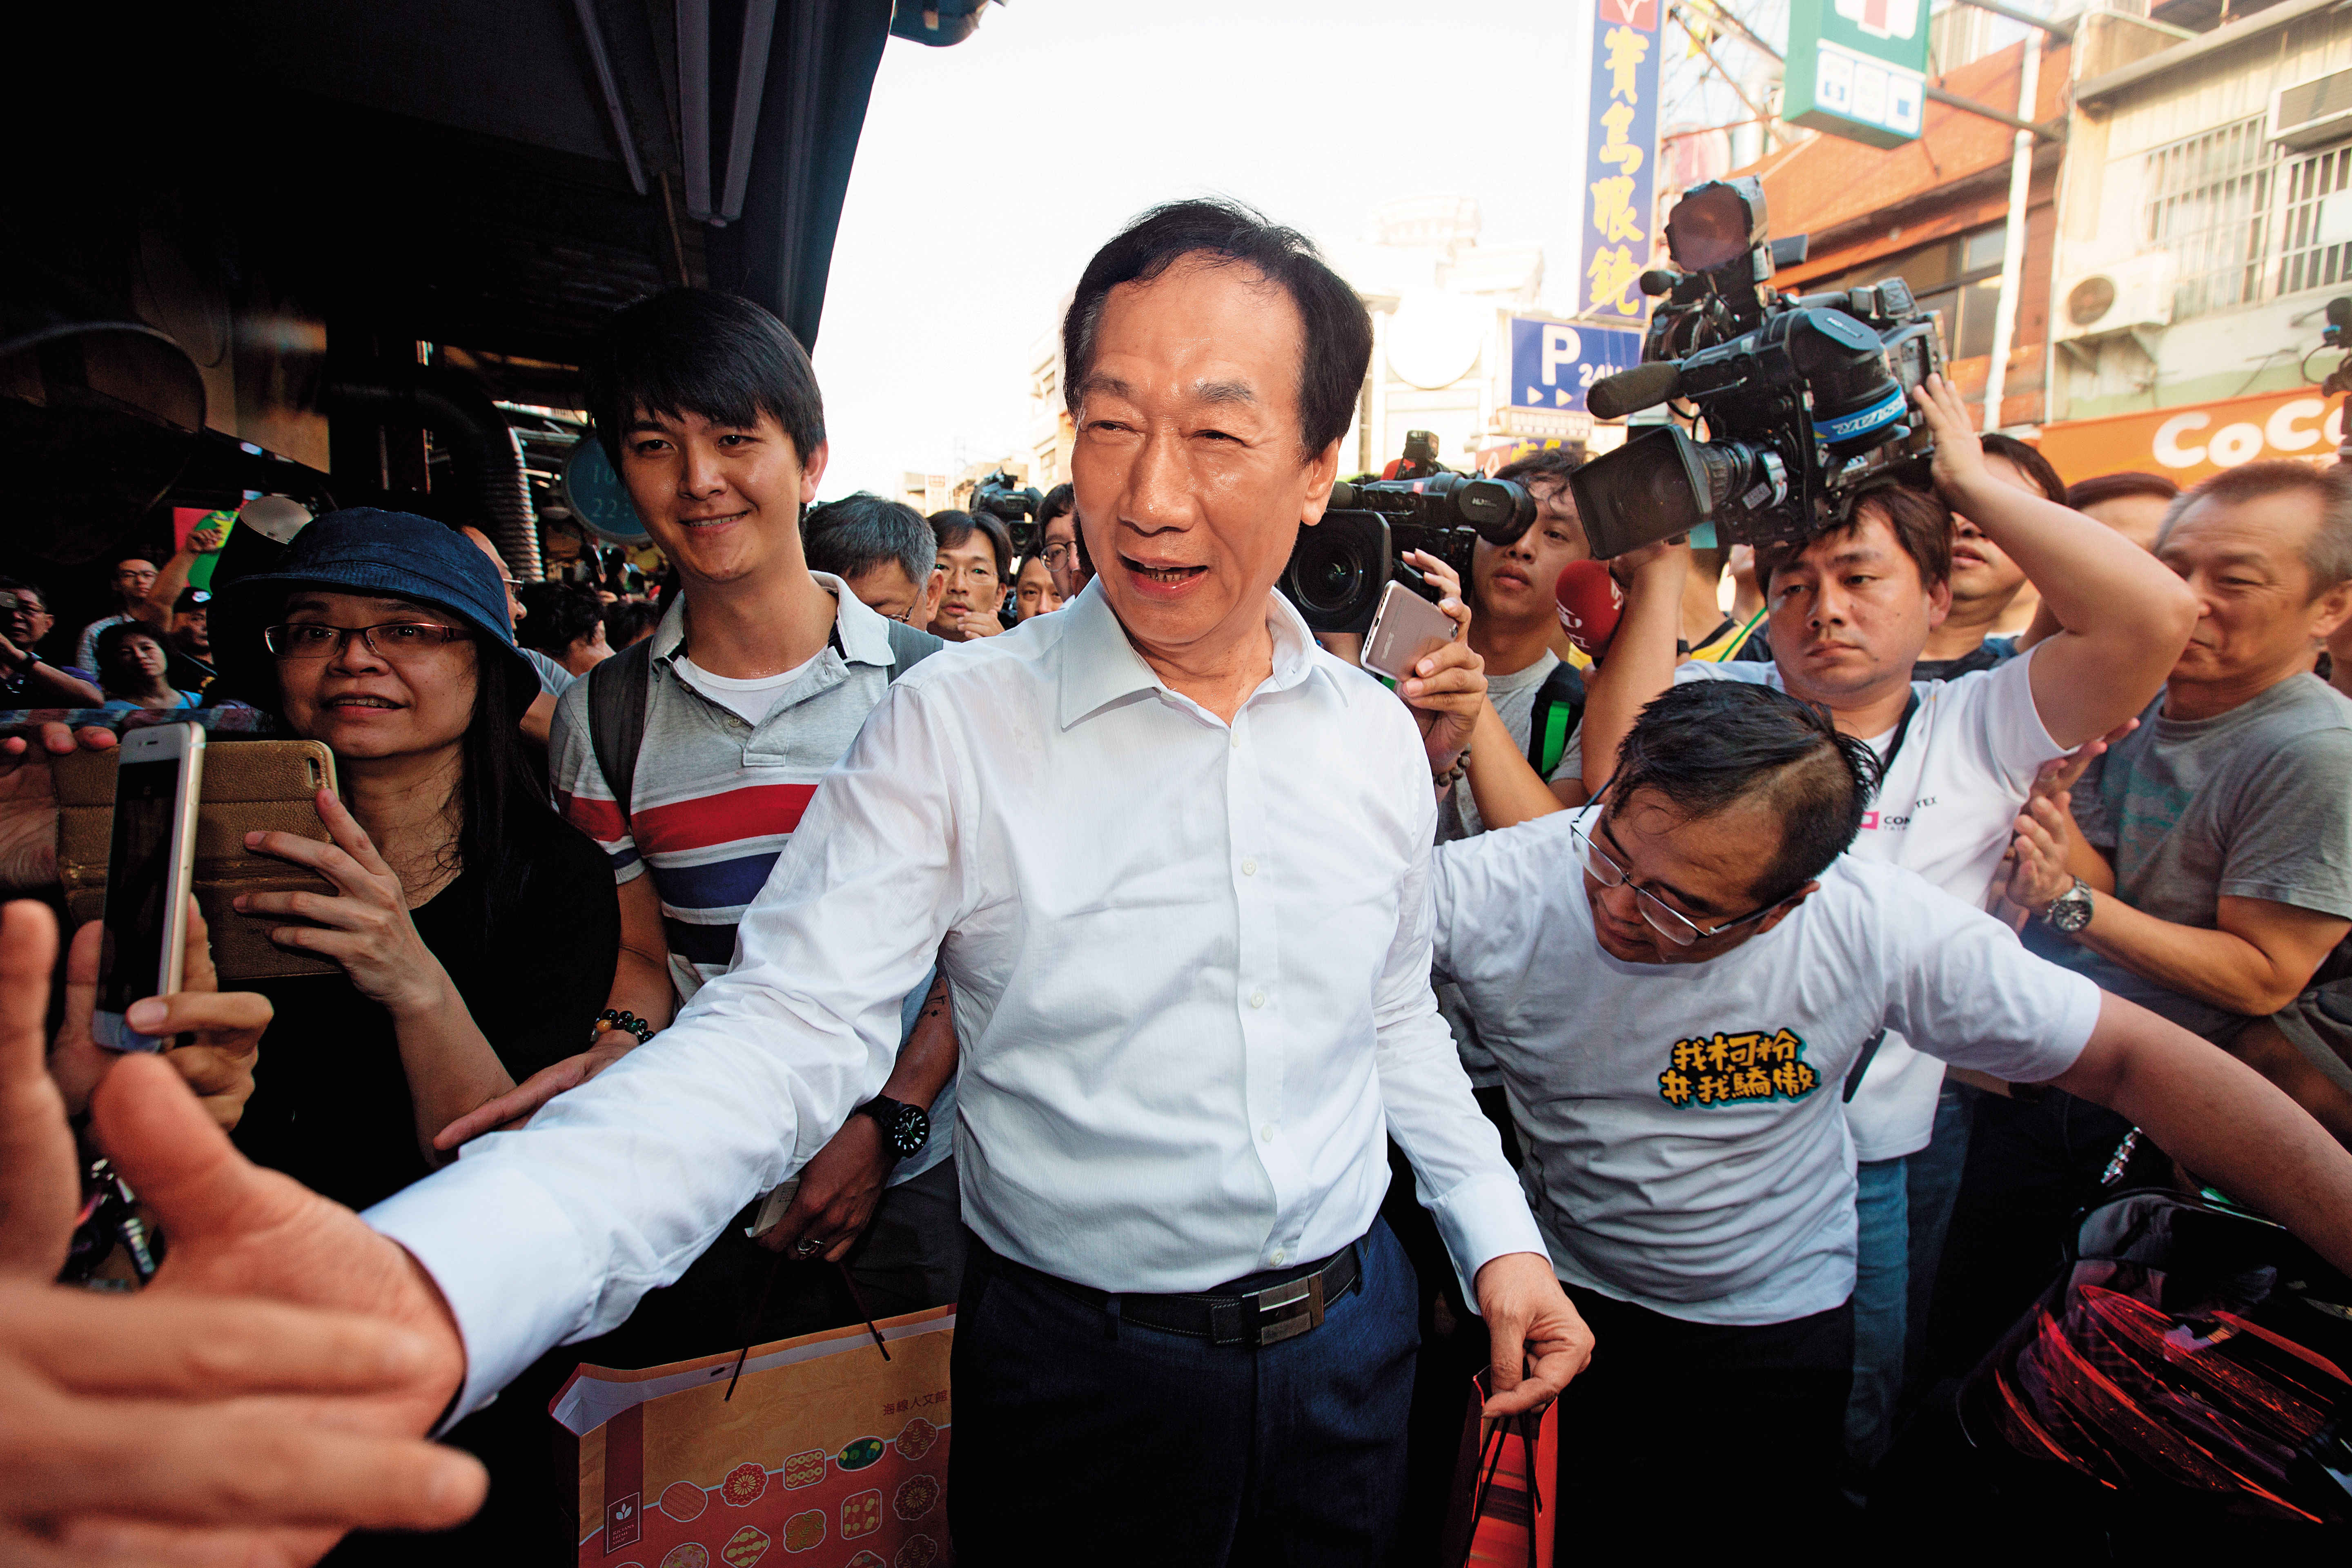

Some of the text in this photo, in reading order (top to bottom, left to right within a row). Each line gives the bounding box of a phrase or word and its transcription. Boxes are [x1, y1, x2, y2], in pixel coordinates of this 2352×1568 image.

[1542, 324, 1581, 385] P
[1673, 1029, 1799, 1071] 我柯粉
[883, 1389, 947, 1416] 海線人文館
[613, 1524, 634, 1536] RICIANS
[613, 1531, 628, 1541] FRESH
[612, 1537, 626, 1545] SHOP
